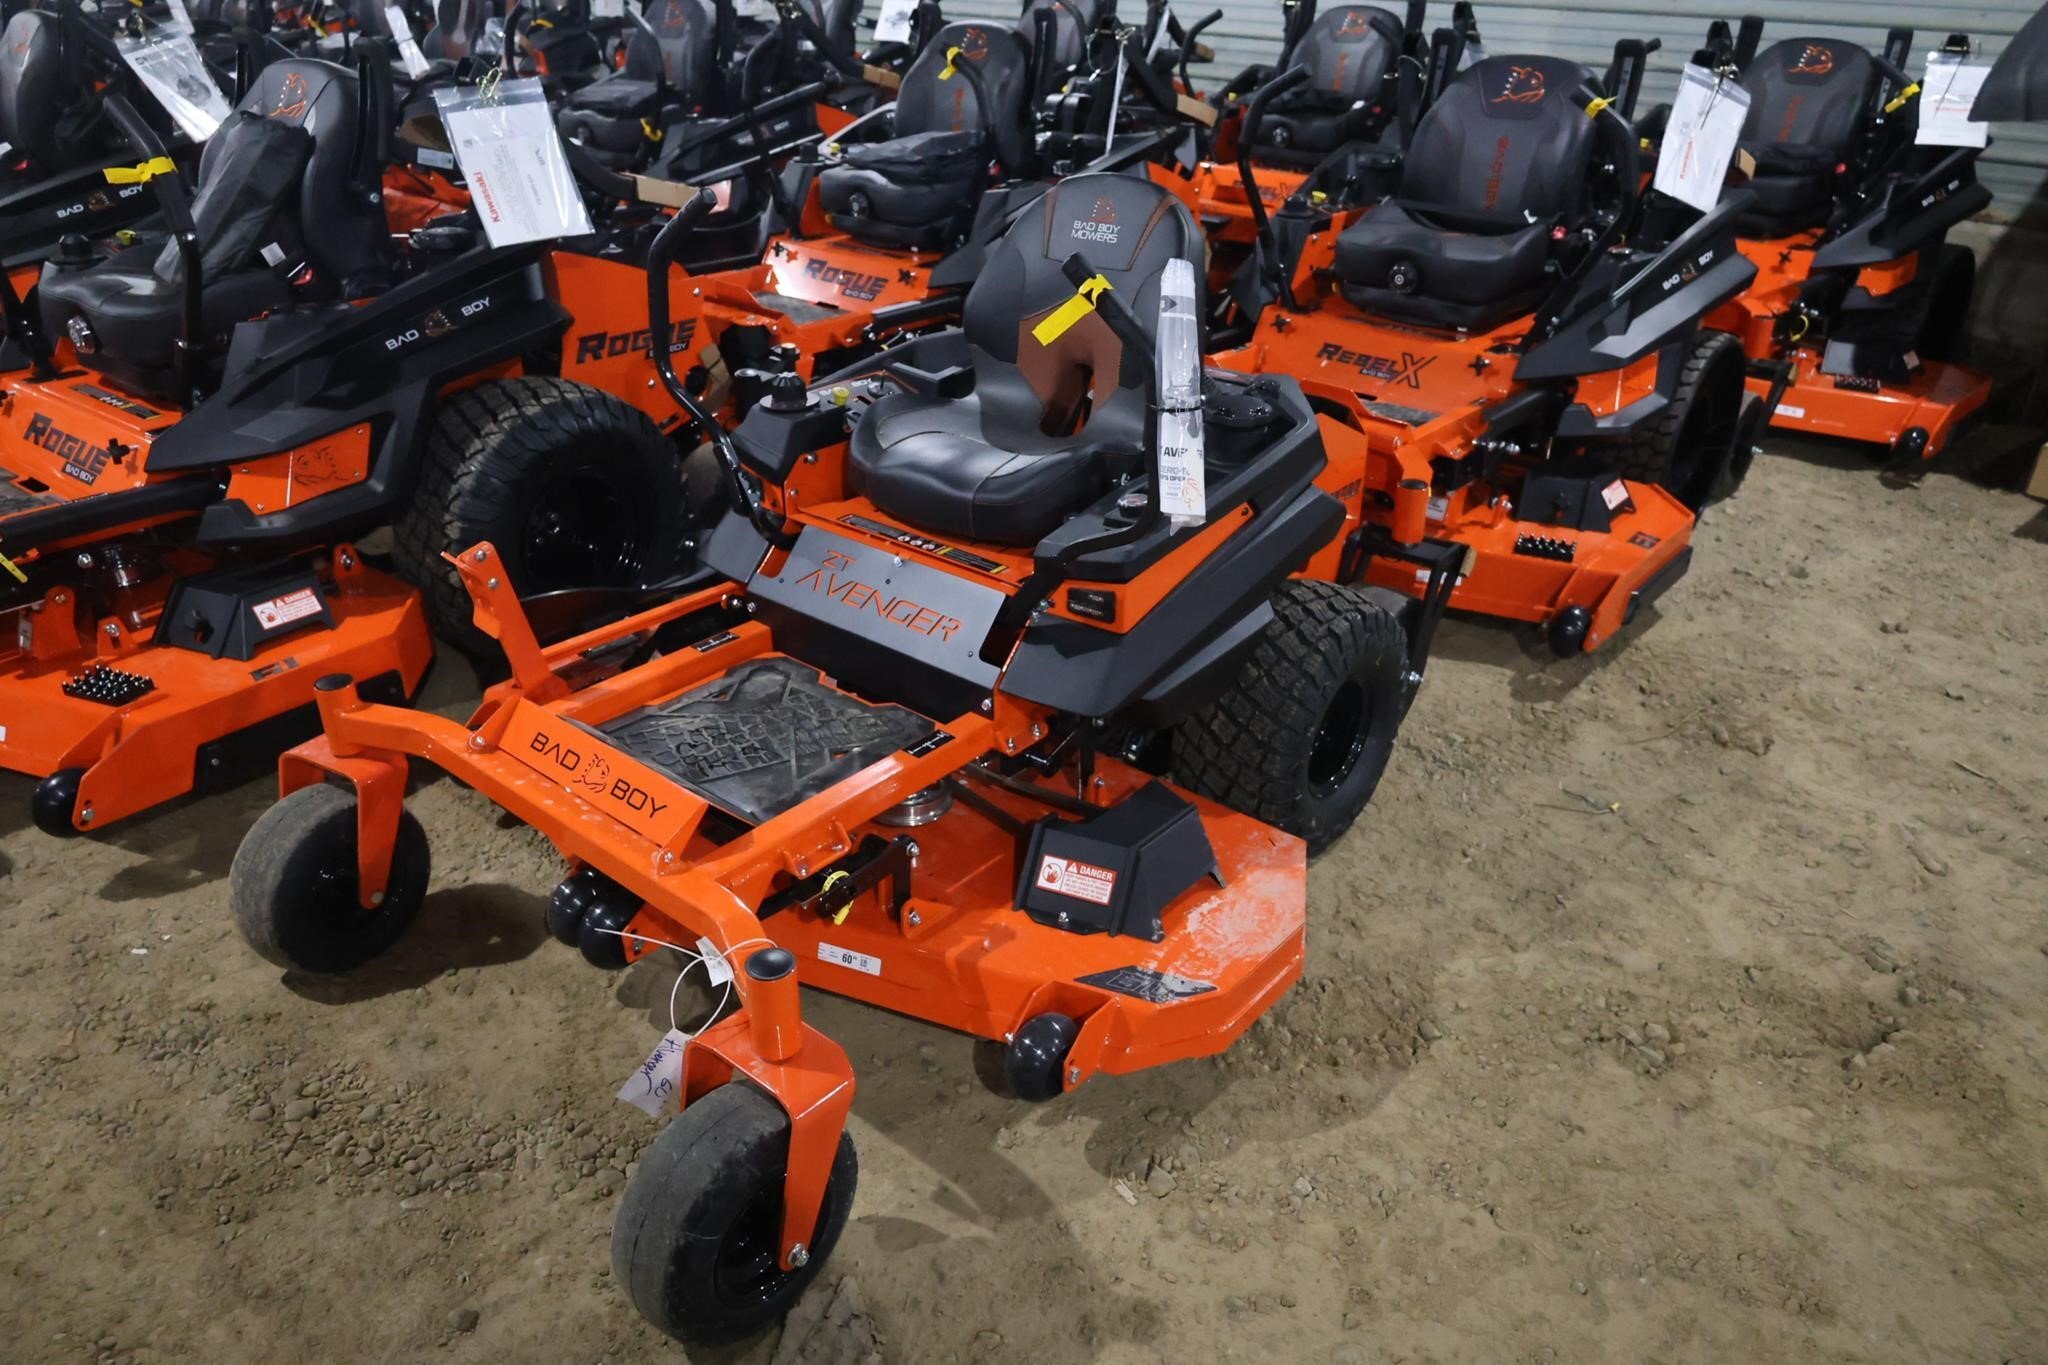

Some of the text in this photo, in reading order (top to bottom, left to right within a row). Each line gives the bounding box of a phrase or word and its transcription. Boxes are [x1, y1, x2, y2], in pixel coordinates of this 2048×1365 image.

[57, 184, 143, 218] BAD BOY
[474, 171, 501, 223] Kawasaki
[1071, 229, 1118, 243] MOWERS
[1073, 220, 1120, 234] BAD BOY
[805, 258, 889, 296] ROGUE
[385, 297, 490, 350] BAD BOY
[1316, 342, 1400, 376] REBEL
[23, 412, 111, 474] ROGUE
[65, 463, 94, 482] BAD BOY
[823, 550, 856, 571] ZT
[795, 568, 962, 642] AVENGER
[530, 732, 667, 818] BAD BOY
[1080, 865, 1113, 881] DANGER
